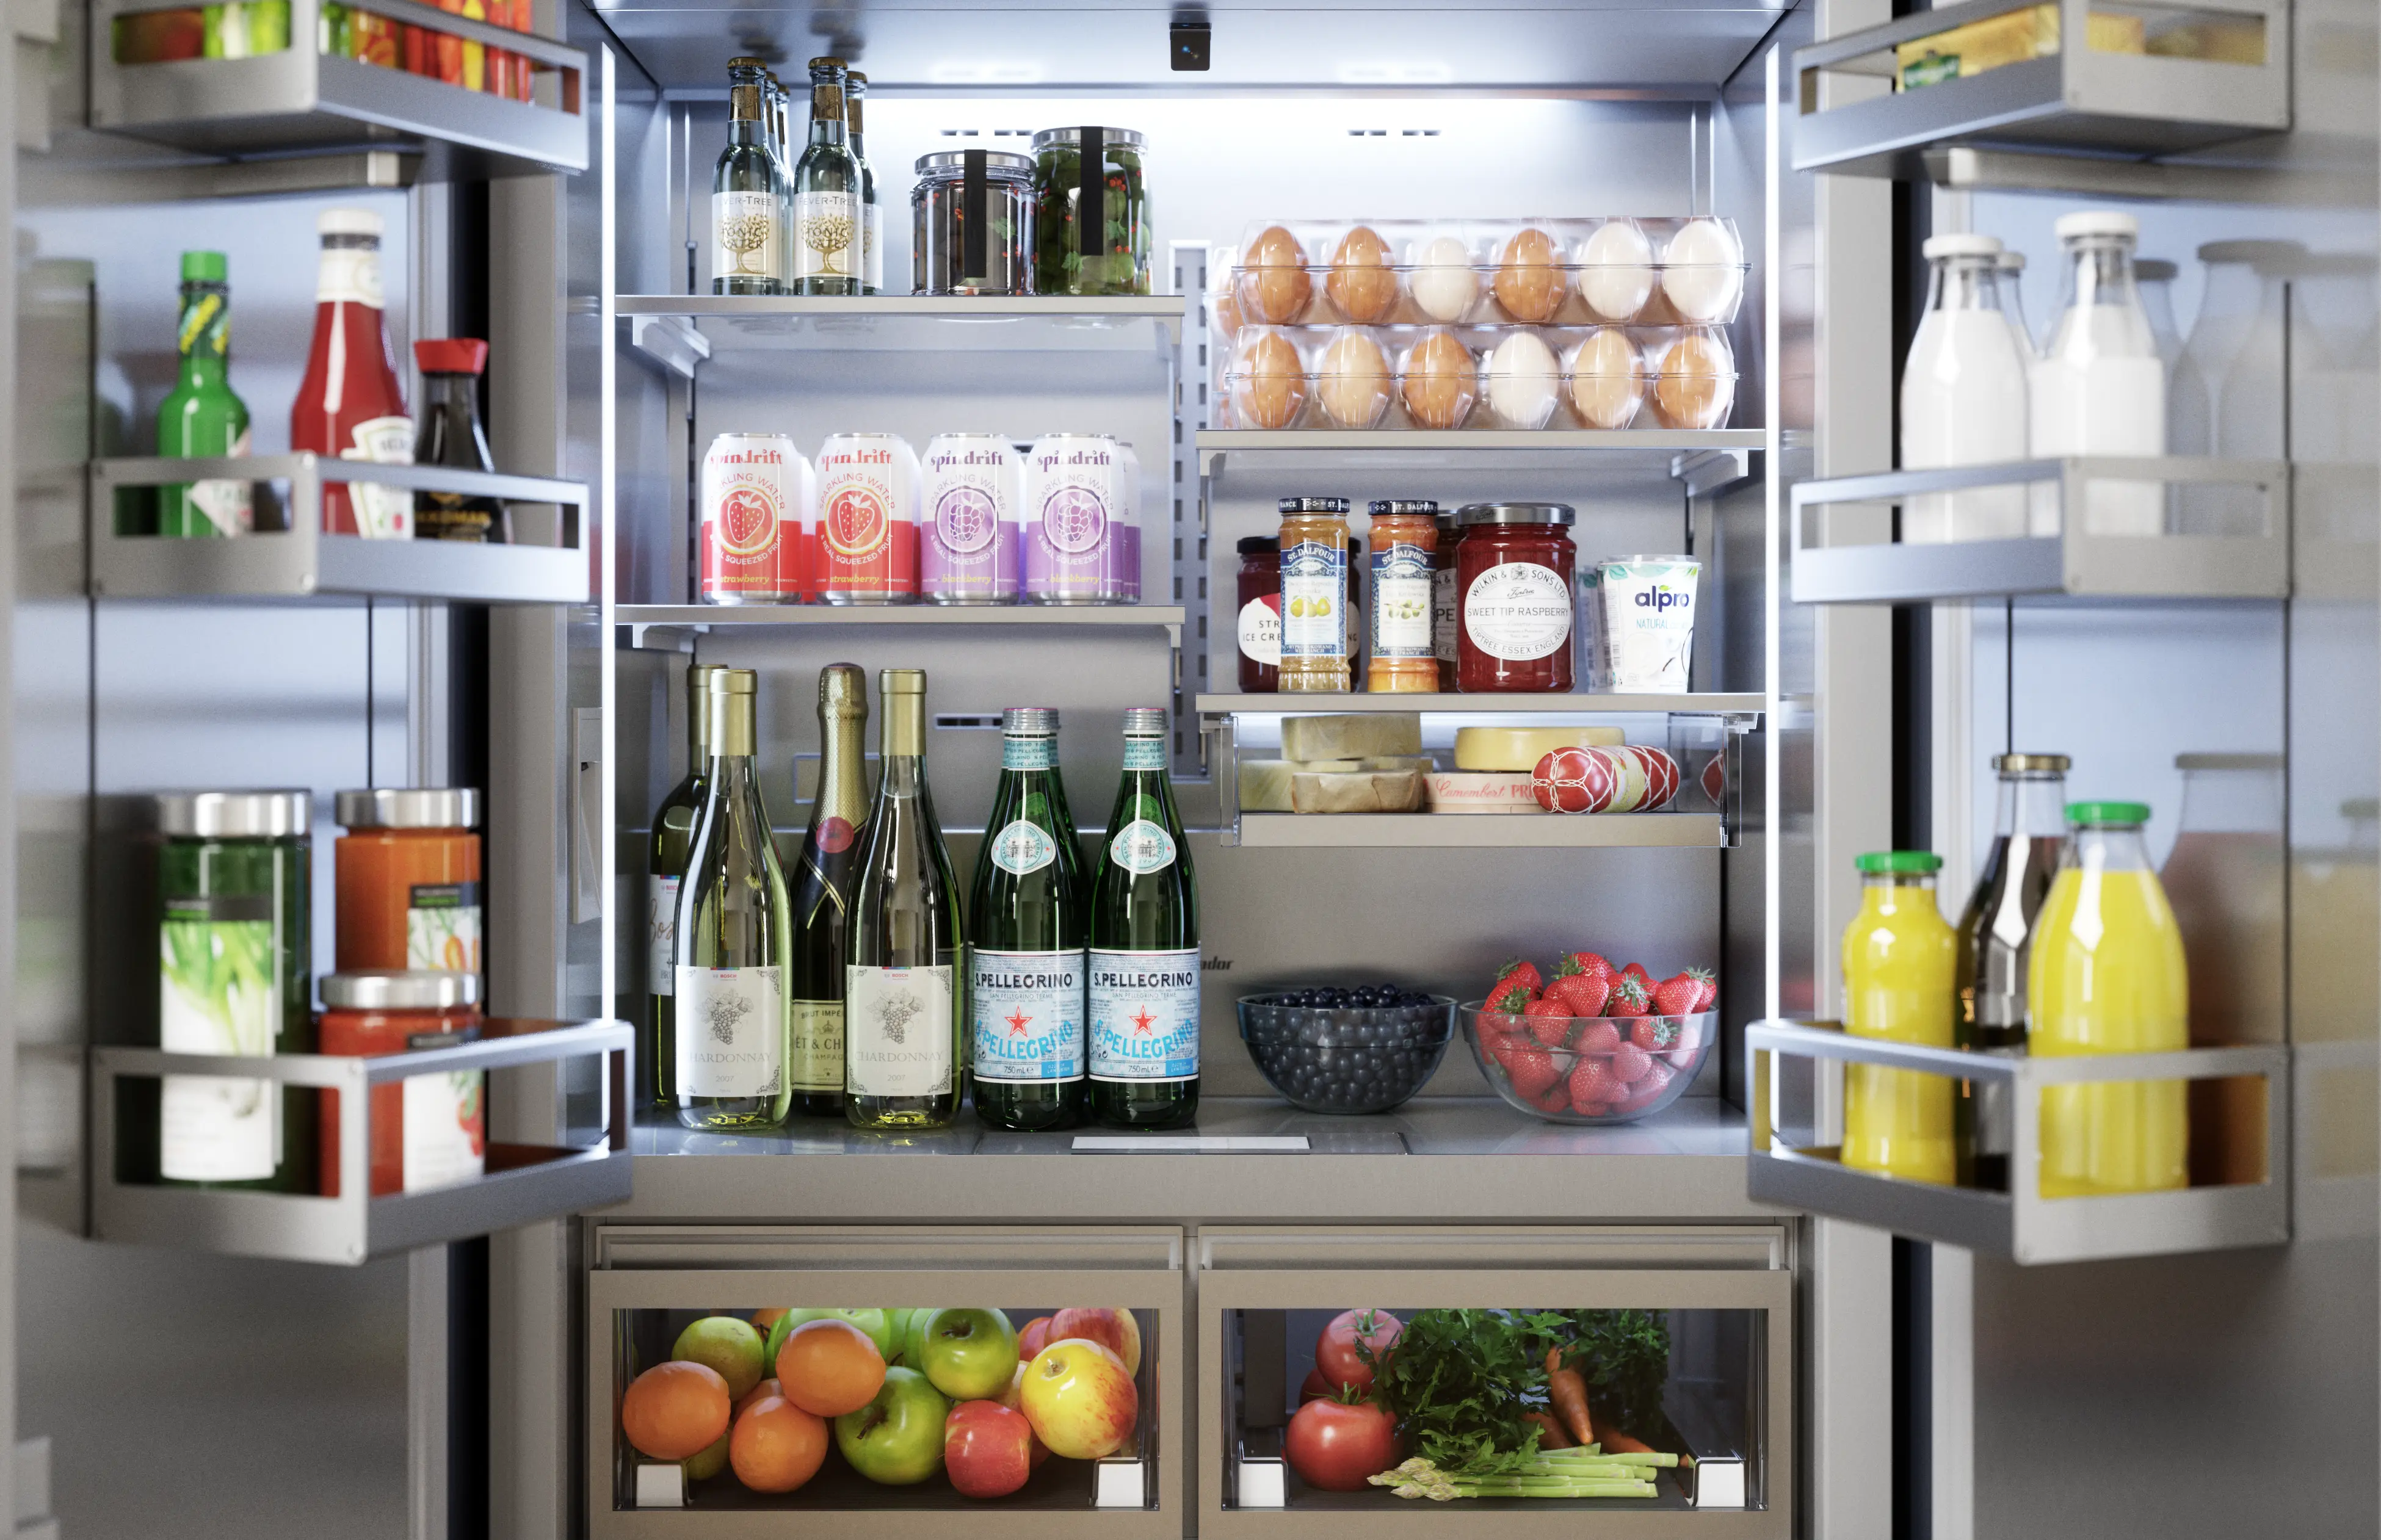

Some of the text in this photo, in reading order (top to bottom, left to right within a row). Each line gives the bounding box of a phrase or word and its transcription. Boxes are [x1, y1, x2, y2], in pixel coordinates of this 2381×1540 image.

[722, 196, 772, 206] VER-TREE
[806, 228, 847, 237] TONIC
[805, 240, 849, 249] WATER
[821, 449, 892, 472] spindrift
[930, 450, 1003, 472] spindrift
[758, 476, 785, 510] WATER
[819, 472, 895, 510] SPARKLING WATER
[929, 473, 1006, 511] SPARKLING WATER
[725, 552, 768, 565] SQUEEZED
[835, 552, 878, 565] SQUEEZED
[948, 552, 990, 565] SQUEEZED
[1298, 548, 1335, 562] DALFOUR
[1393, 551, 1428, 566] DALFOUR
[830, 574, 880, 585] strawberry
[1471, 573, 1498, 597] WILKIN
[1531, 569, 1553, 586] SONS
[1554, 584, 1566, 598] LTD
[1634, 585, 1689, 612] alpro
[1467, 607, 1568, 616] SWEET TIP RASPBERRY
[1636, 618, 1668, 629] NATURAL
[1473, 626, 1498, 651] TIPTREE
[1502, 646, 1531, 654] ESSEX
[1535, 626, 1566, 653] ENGLAND
[1436, 778, 1506, 798] Camembert
[976, 973, 1072, 988] S.PELLEGRINO
[1094, 972, 1192, 987] S.PELLEGRINO
[812, 1038, 819, 1050] &
[824, 1038, 841, 1050] CH
[976, 1019, 1073, 1060] S.PELLEGRINO
[1094, 1019, 1193, 1058] S.PELLEGRINO
[690, 1052, 772, 1063] HARDONNAY
[855, 1051, 943, 1063] CHARDONNAY
